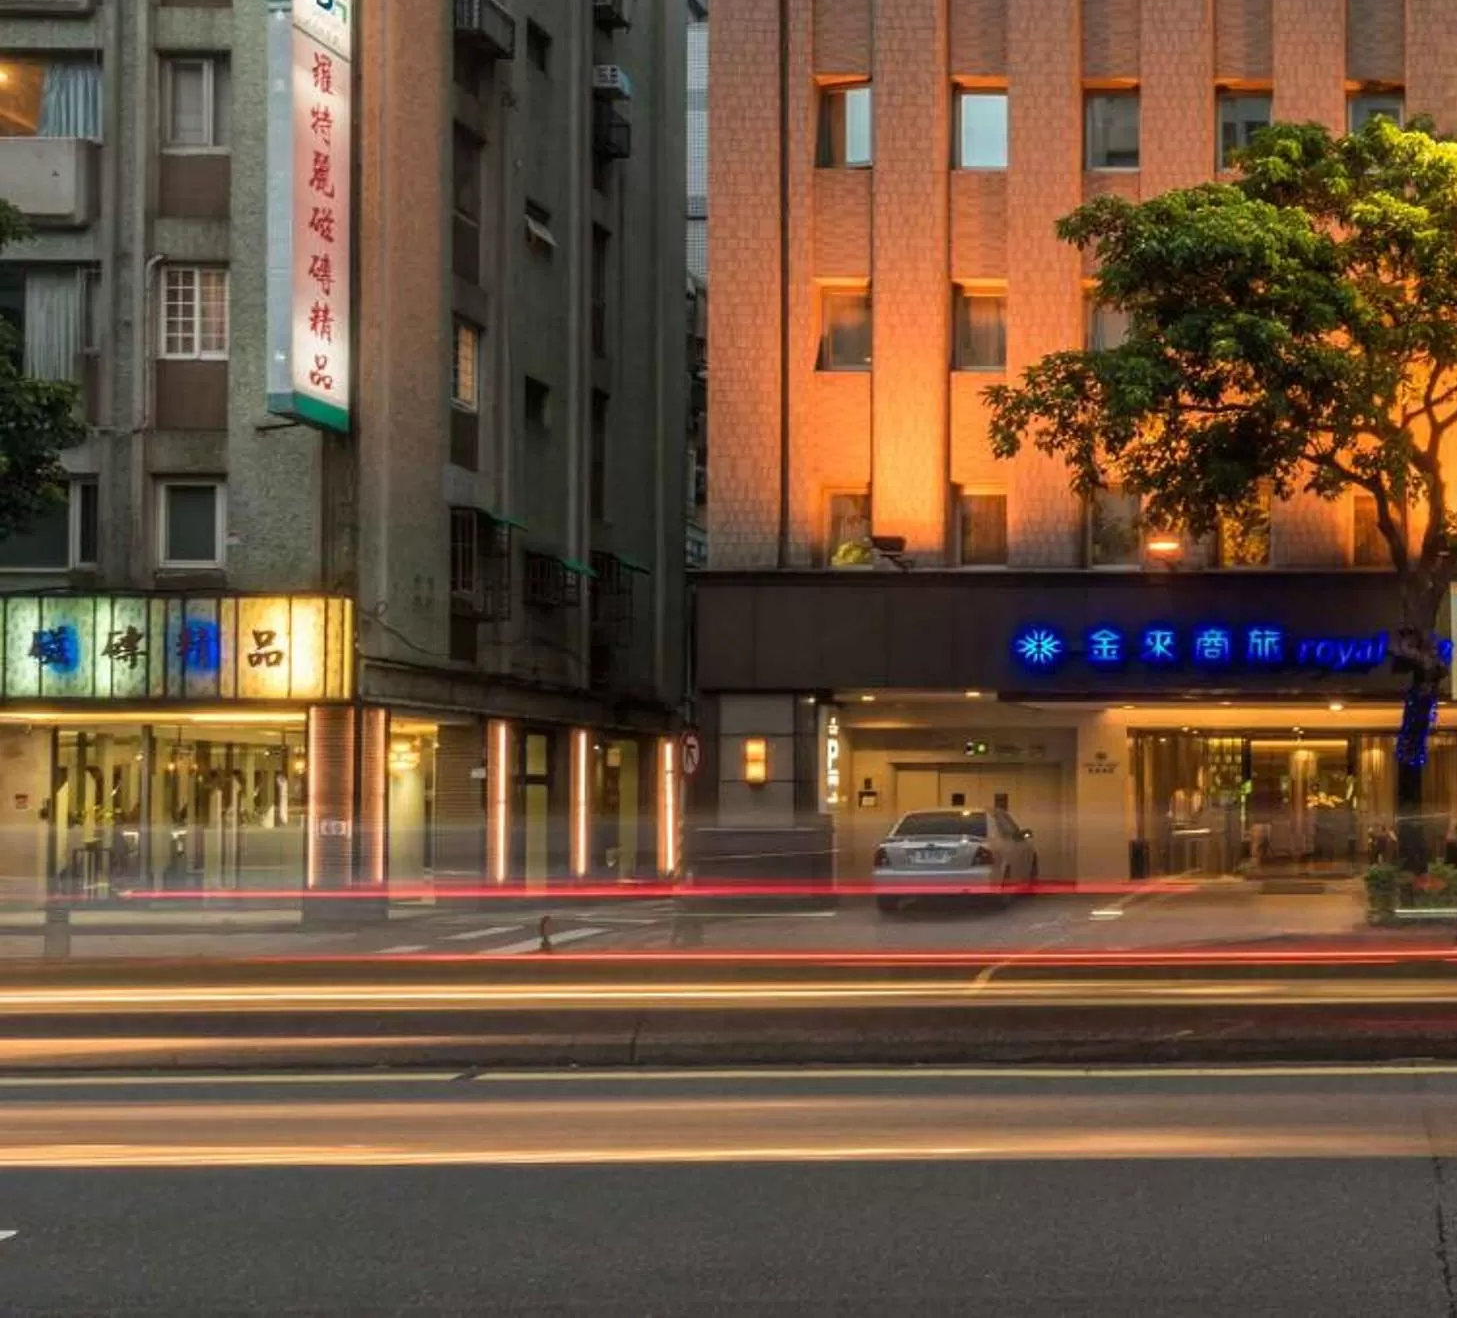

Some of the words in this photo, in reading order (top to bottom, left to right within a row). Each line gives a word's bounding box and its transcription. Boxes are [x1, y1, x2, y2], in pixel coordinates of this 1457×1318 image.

[1090, 629, 1281, 661] 金來商旅
[1300, 632, 1388, 668] royal
